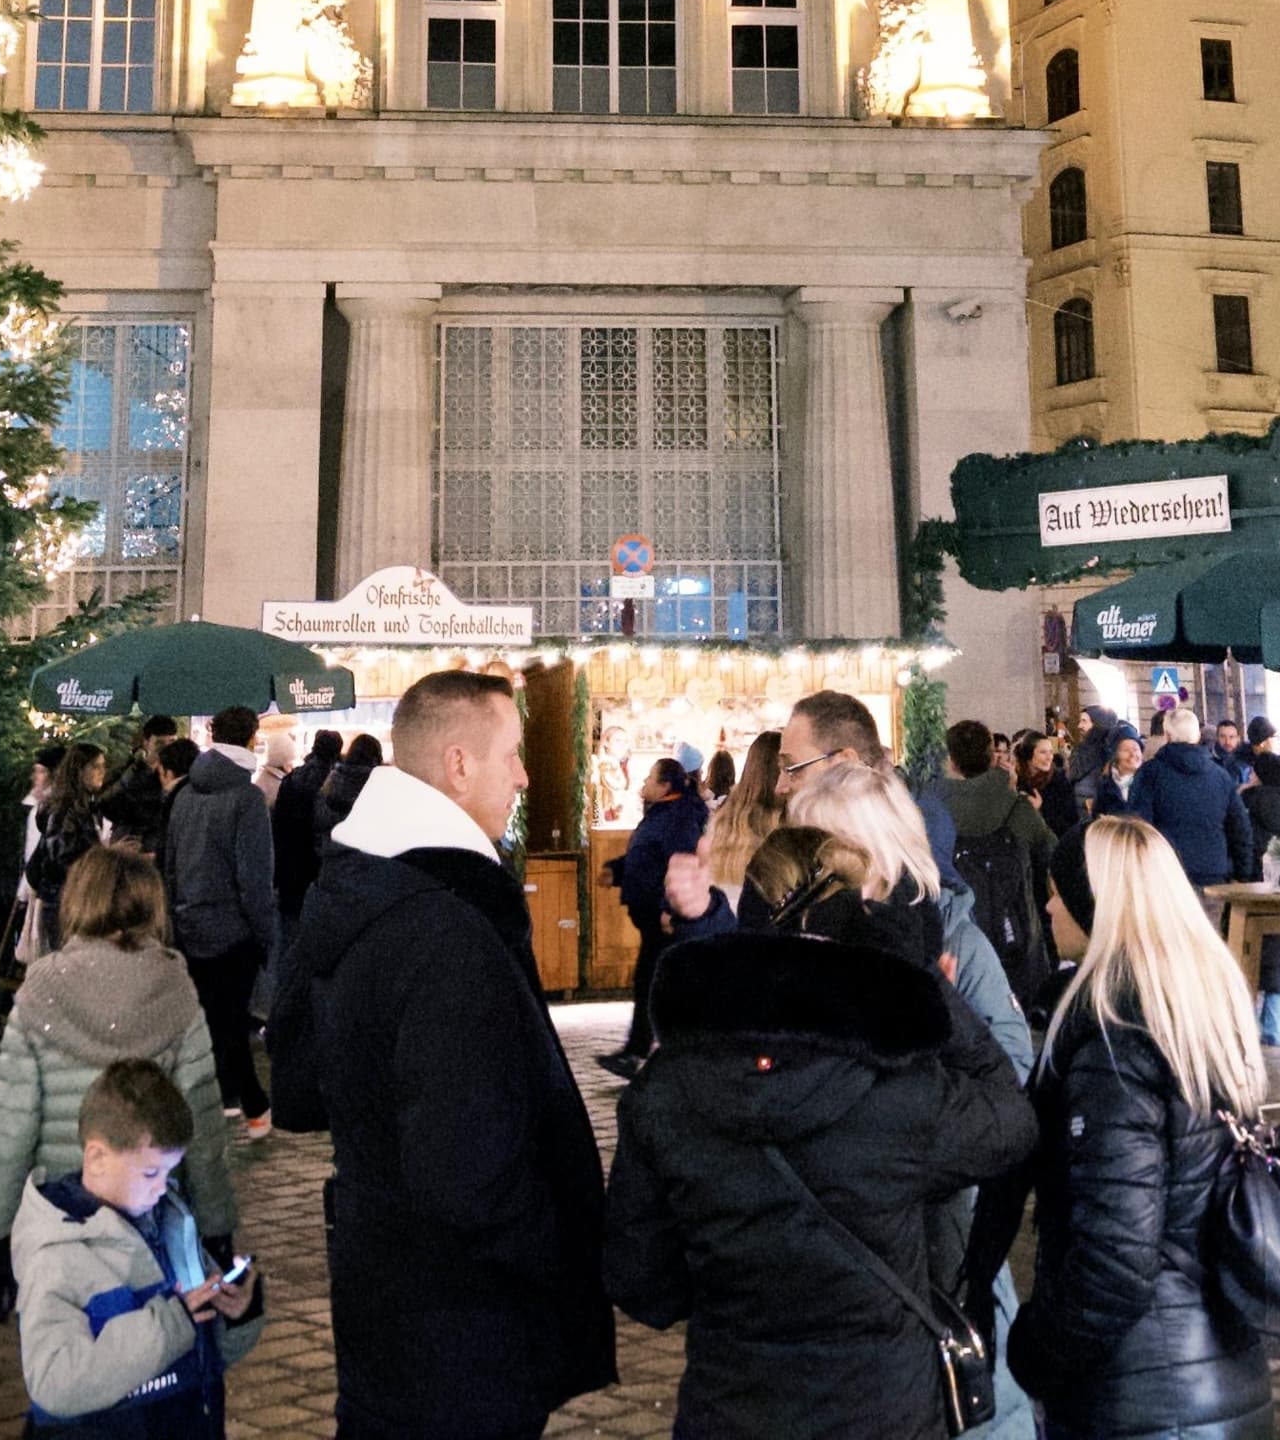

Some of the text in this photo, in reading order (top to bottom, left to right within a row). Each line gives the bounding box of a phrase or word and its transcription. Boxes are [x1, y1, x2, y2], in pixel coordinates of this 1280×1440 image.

[1045, 492, 1224, 533] Auf Wiedersehen!
[365, 585, 442, 609] Ofenfrische
[272, 610, 525, 639] Schaumrollen und Topfenbällchen
[1102, 618, 1158, 639] wiener
[60, 690, 113, 707] wiener
[294, 689, 336, 705] wiener
